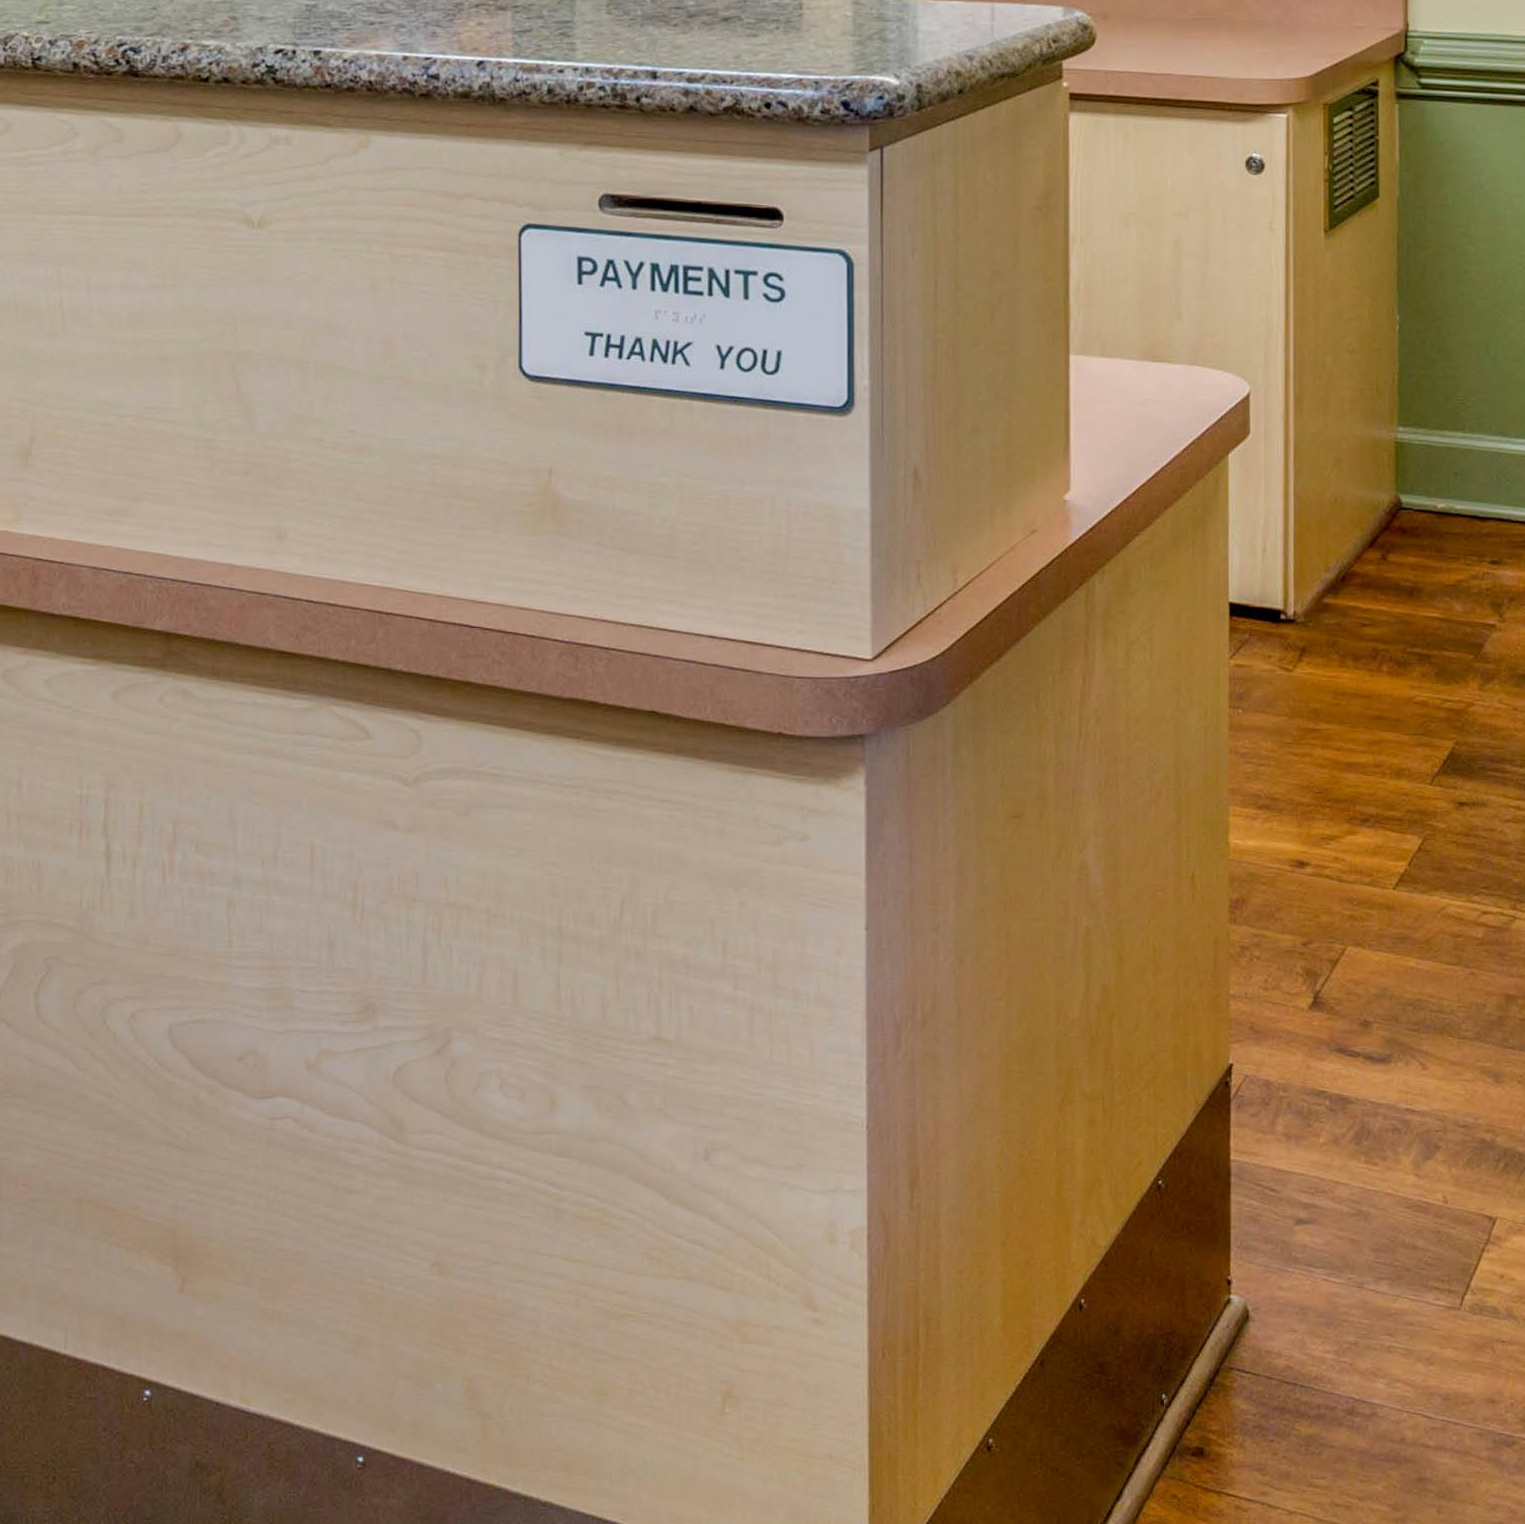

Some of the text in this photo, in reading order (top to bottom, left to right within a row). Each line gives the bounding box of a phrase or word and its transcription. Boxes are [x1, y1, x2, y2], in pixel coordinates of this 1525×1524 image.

[577, 256, 787, 303] PAYMENTS
[584, 331, 783, 376] THANK YOU
